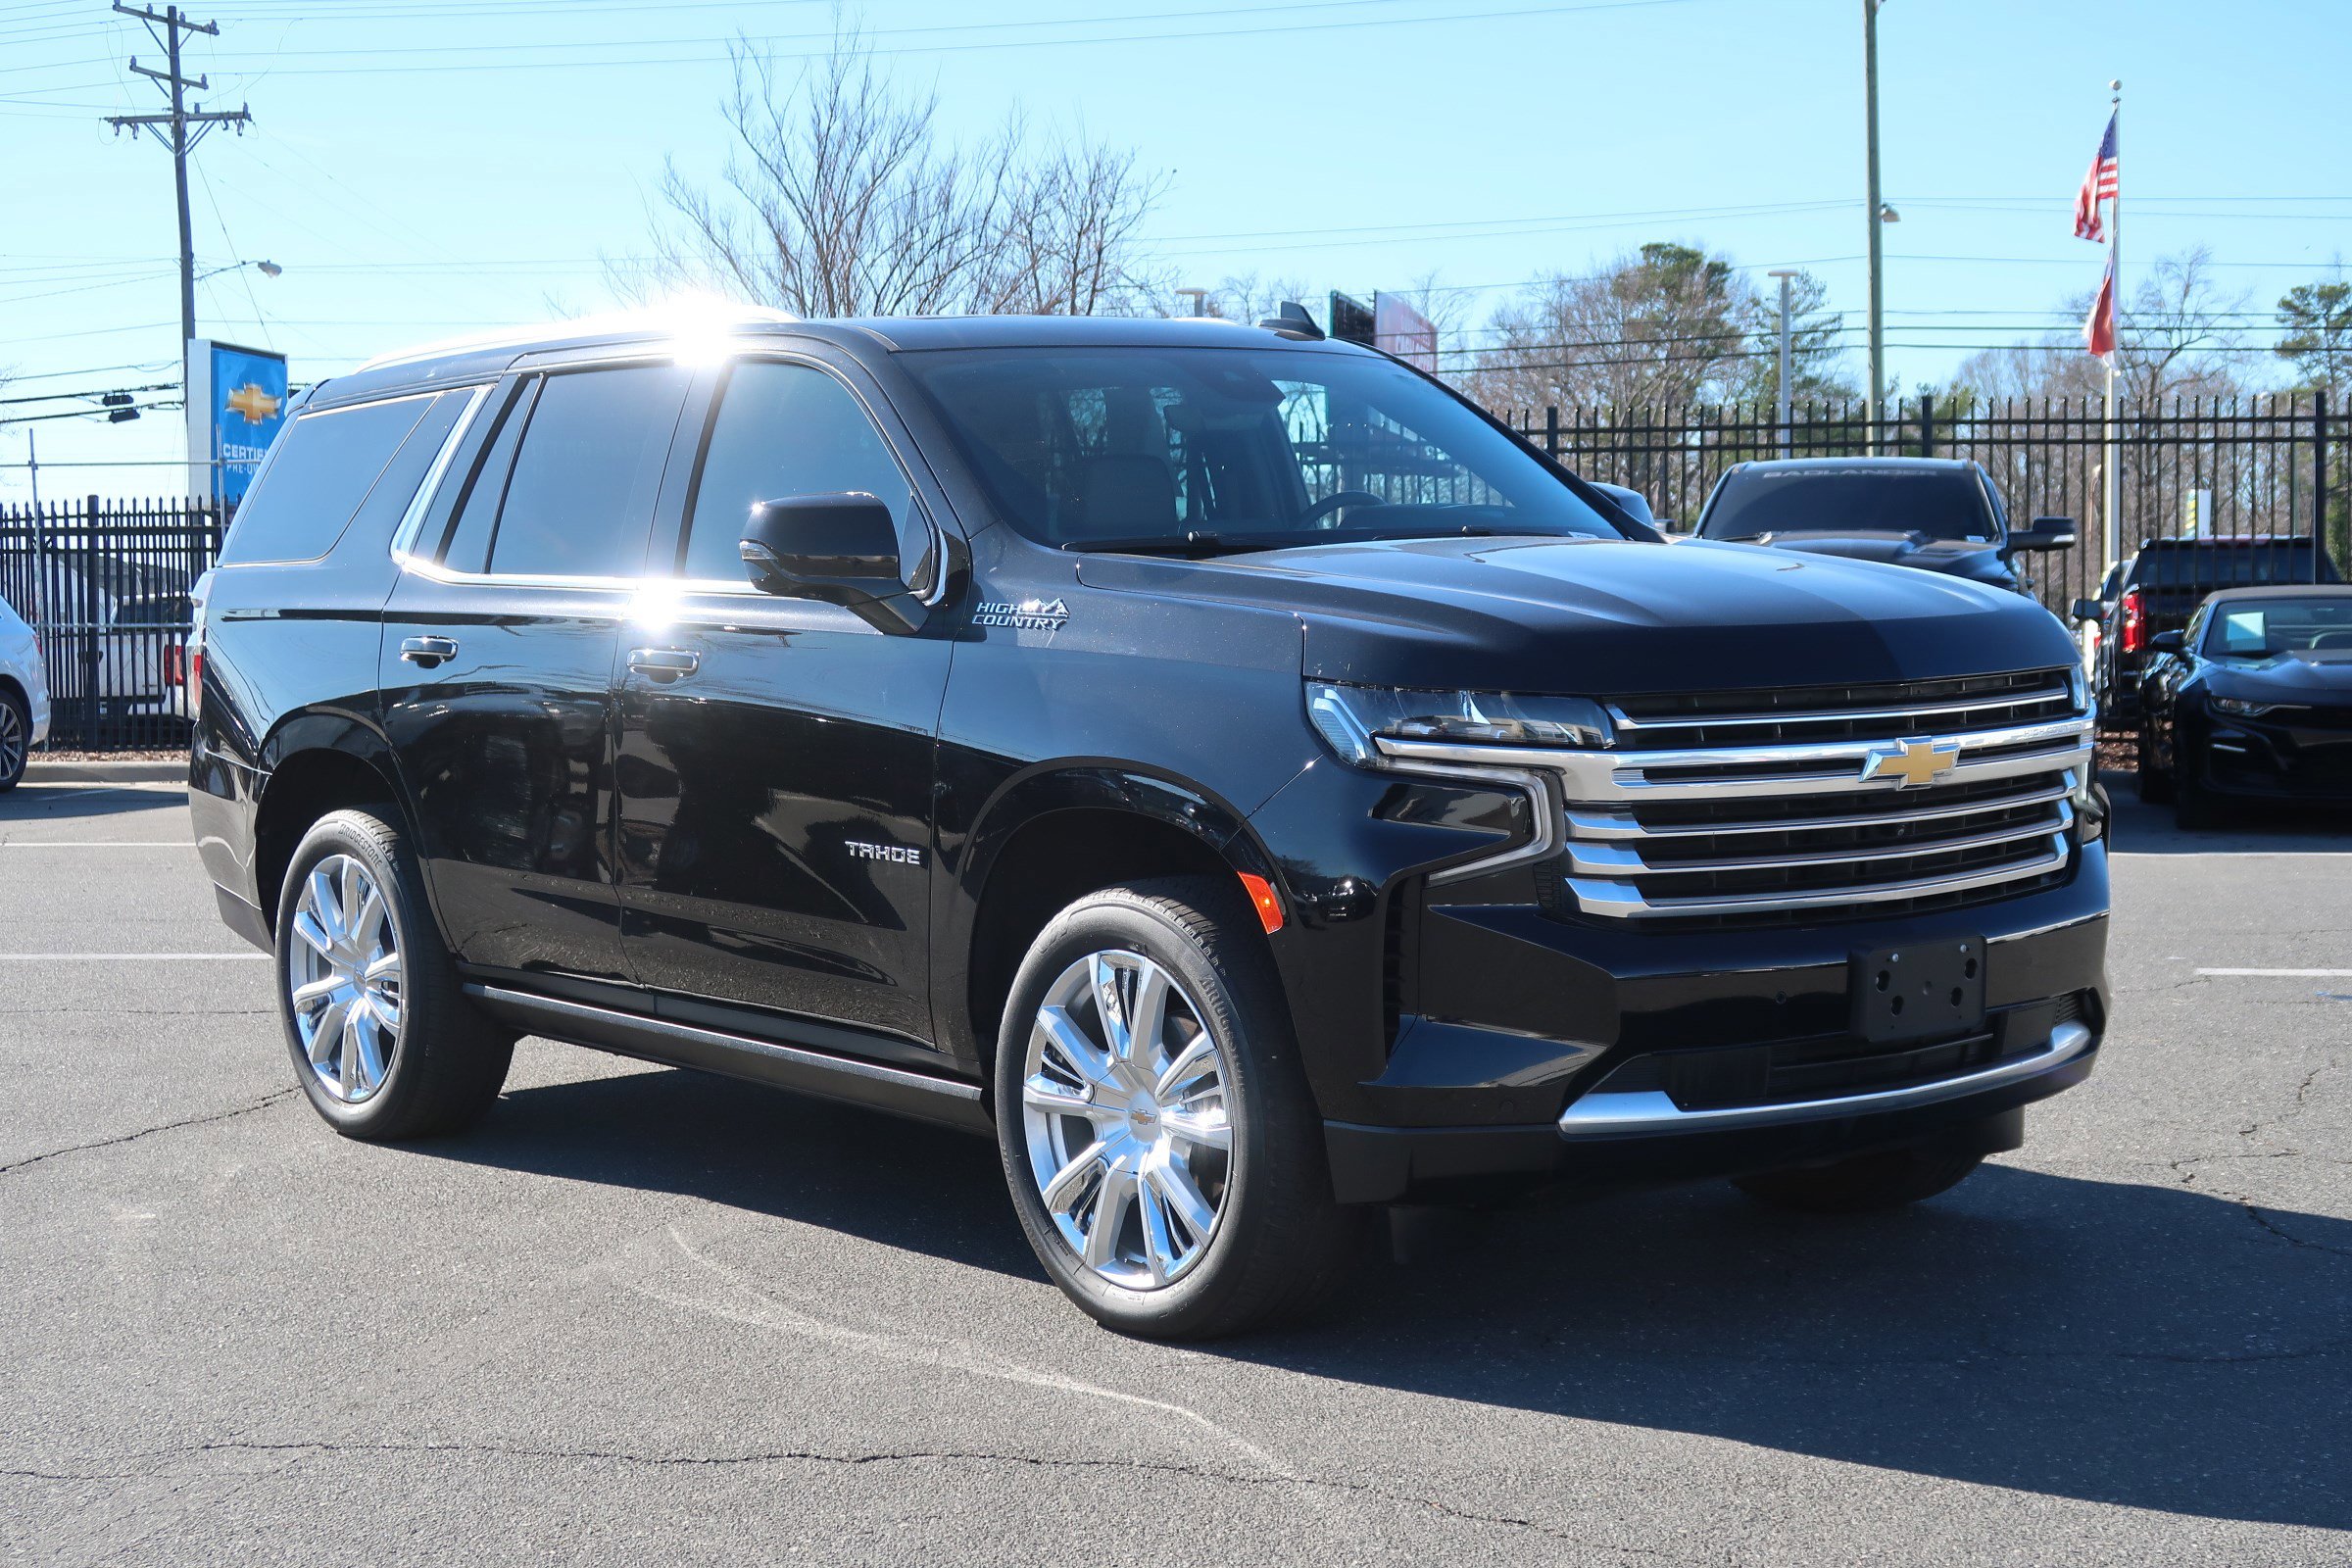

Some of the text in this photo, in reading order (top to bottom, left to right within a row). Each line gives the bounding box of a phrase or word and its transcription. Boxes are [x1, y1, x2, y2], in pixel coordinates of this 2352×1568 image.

[976, 602, 1021, 615] HIGH
[971, 614, 1067, 631] COUNTRY
[338, 823, 383, 869] BRIDGESTONE
[845, 841, 920, 865] TAHOE
